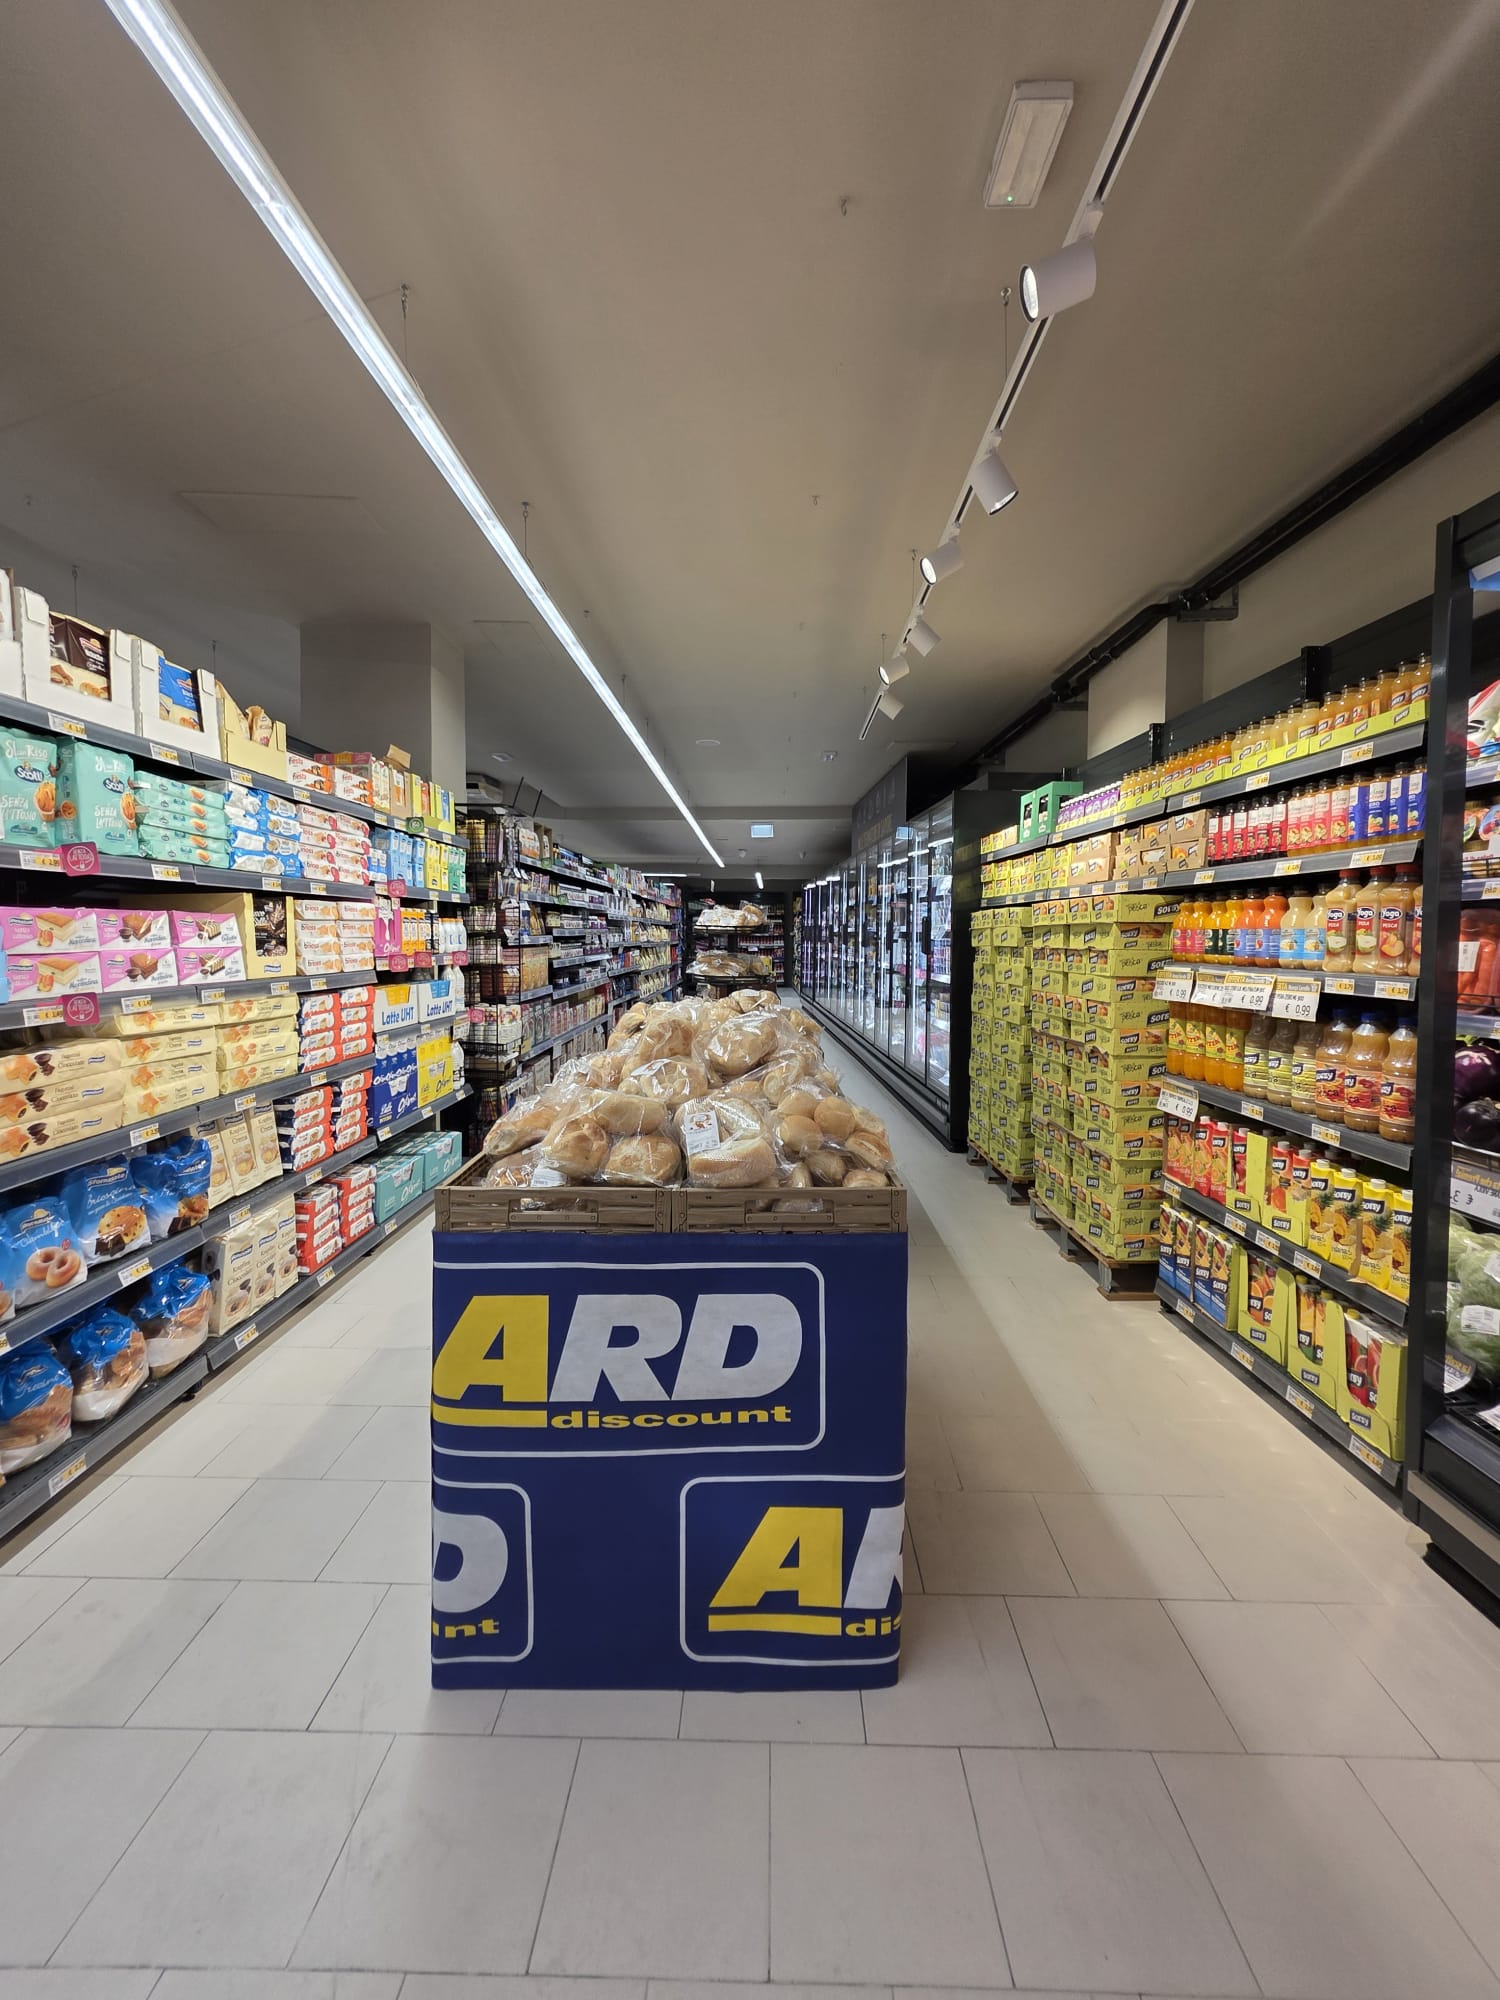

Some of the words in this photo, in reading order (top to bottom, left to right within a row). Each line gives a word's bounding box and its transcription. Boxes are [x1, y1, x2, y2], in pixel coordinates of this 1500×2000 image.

[1382, 910, 1399, 919] Yoga
[1249, 995, 1264, 1006] 0.99
[427, 1004, 441, 1016] Latte
[442, 1001, 453, 1013] UHT
[1285, 1003, 1290, 1013] €
[1296, 1004, 1311, 1016] 0.99
[381, 1011, 399, 1026] Latte
[400, 1007, 414, 1022] UHT
[432, 1294, 803, 1402] ARD
[551, 1405, 792, 1430] discount
